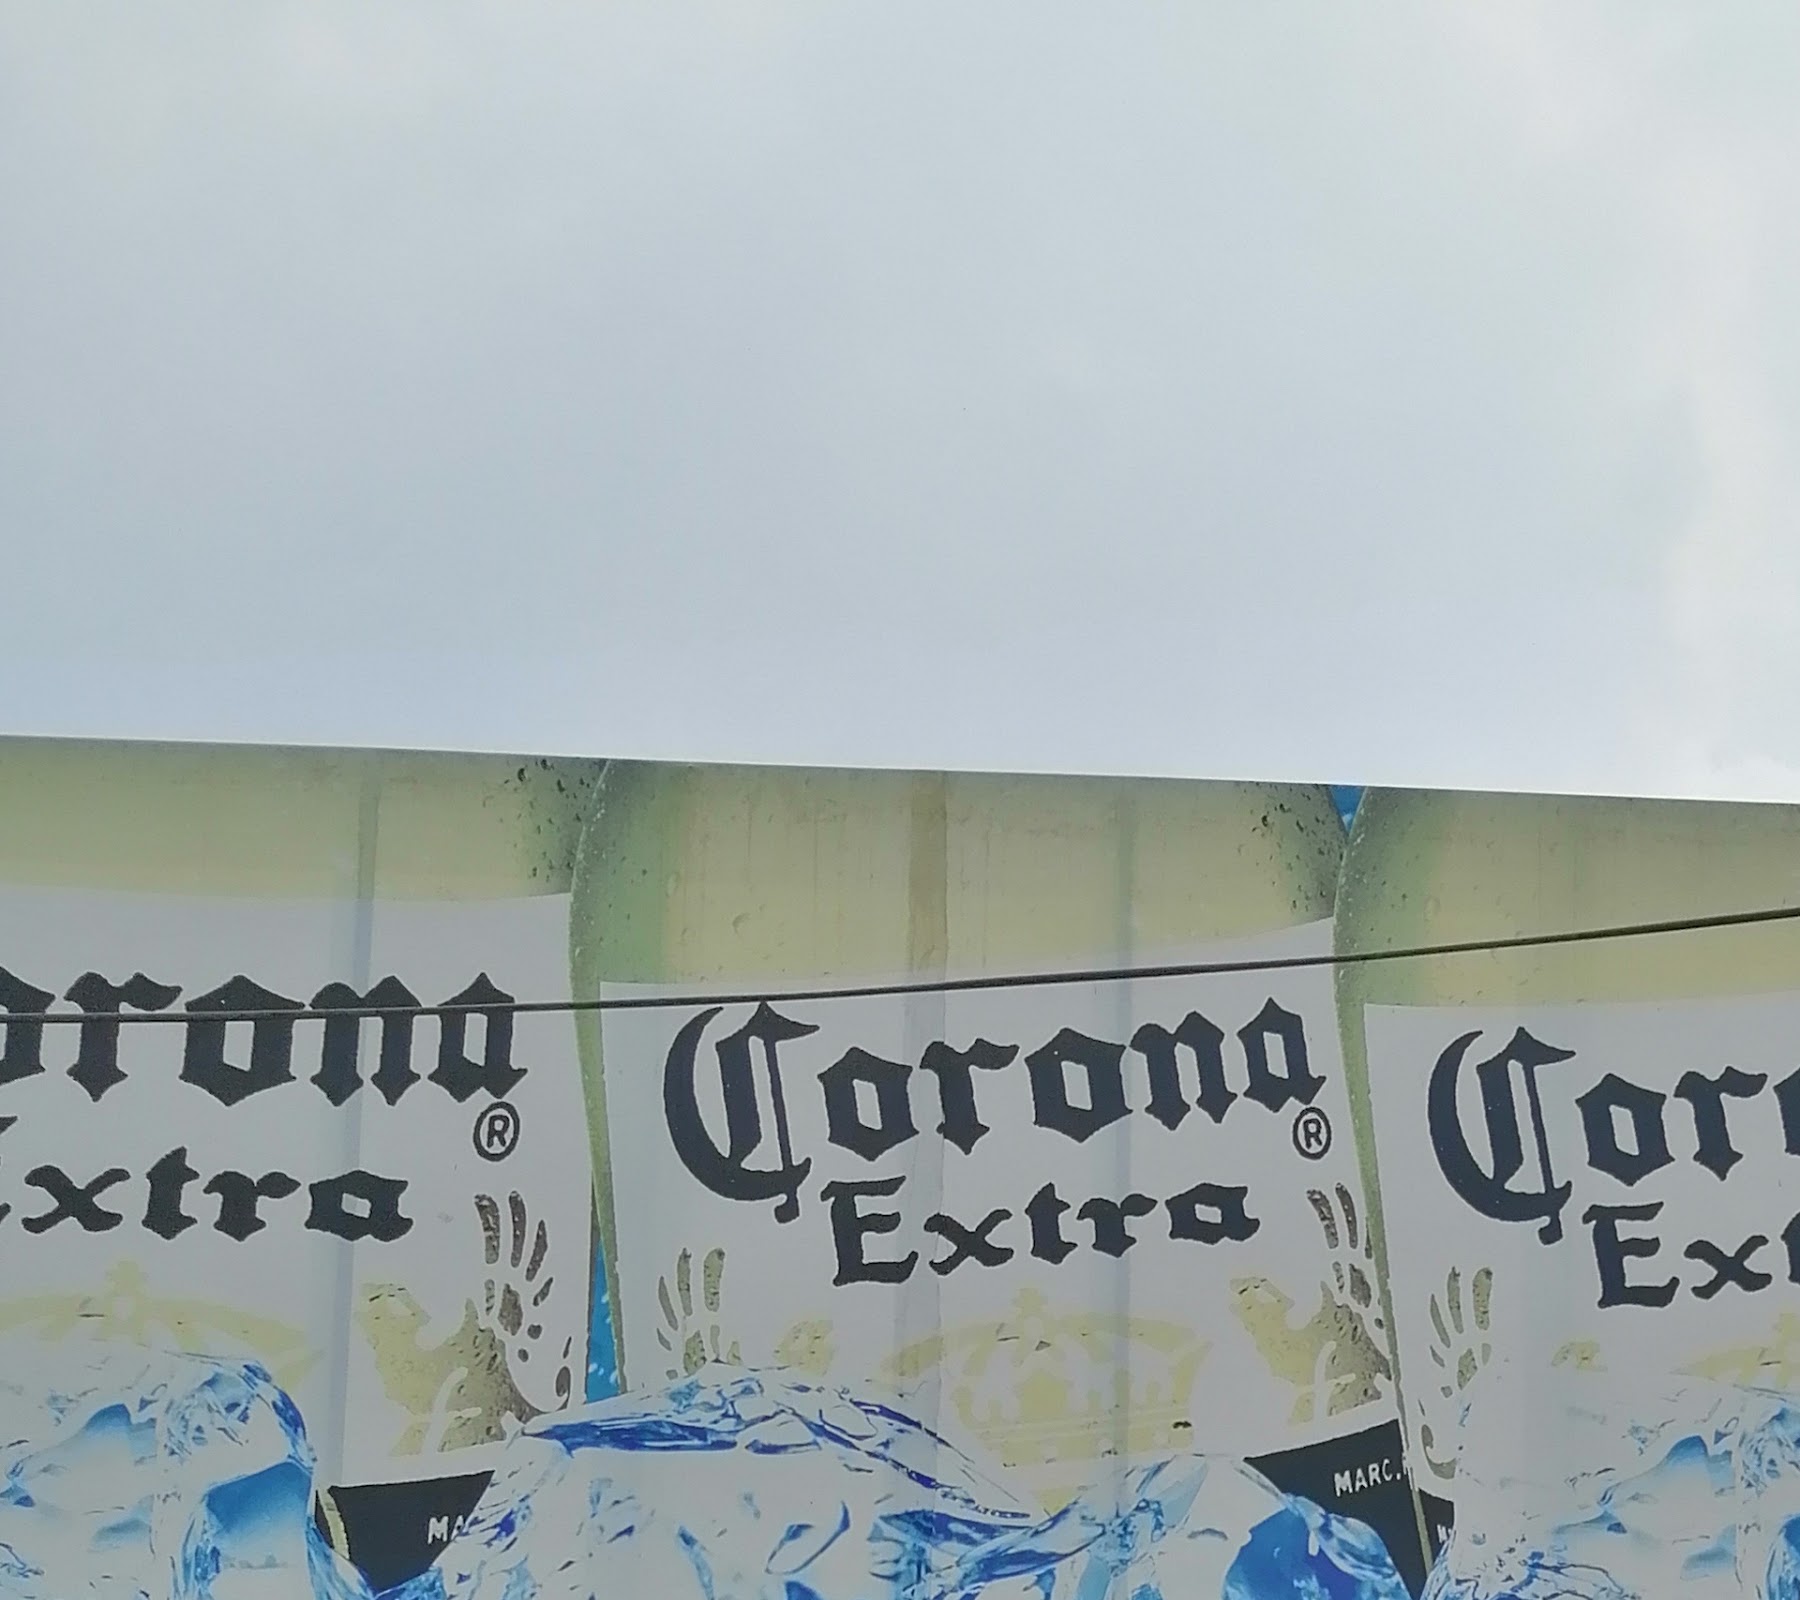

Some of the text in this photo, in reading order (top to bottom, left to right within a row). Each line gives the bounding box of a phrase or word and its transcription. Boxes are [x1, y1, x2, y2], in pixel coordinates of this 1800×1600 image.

[663, 997, 1327, 1224] Corona
[0, 1116, 412, 1242] xtra
[822, 1175, 1261, 1287] Extra
